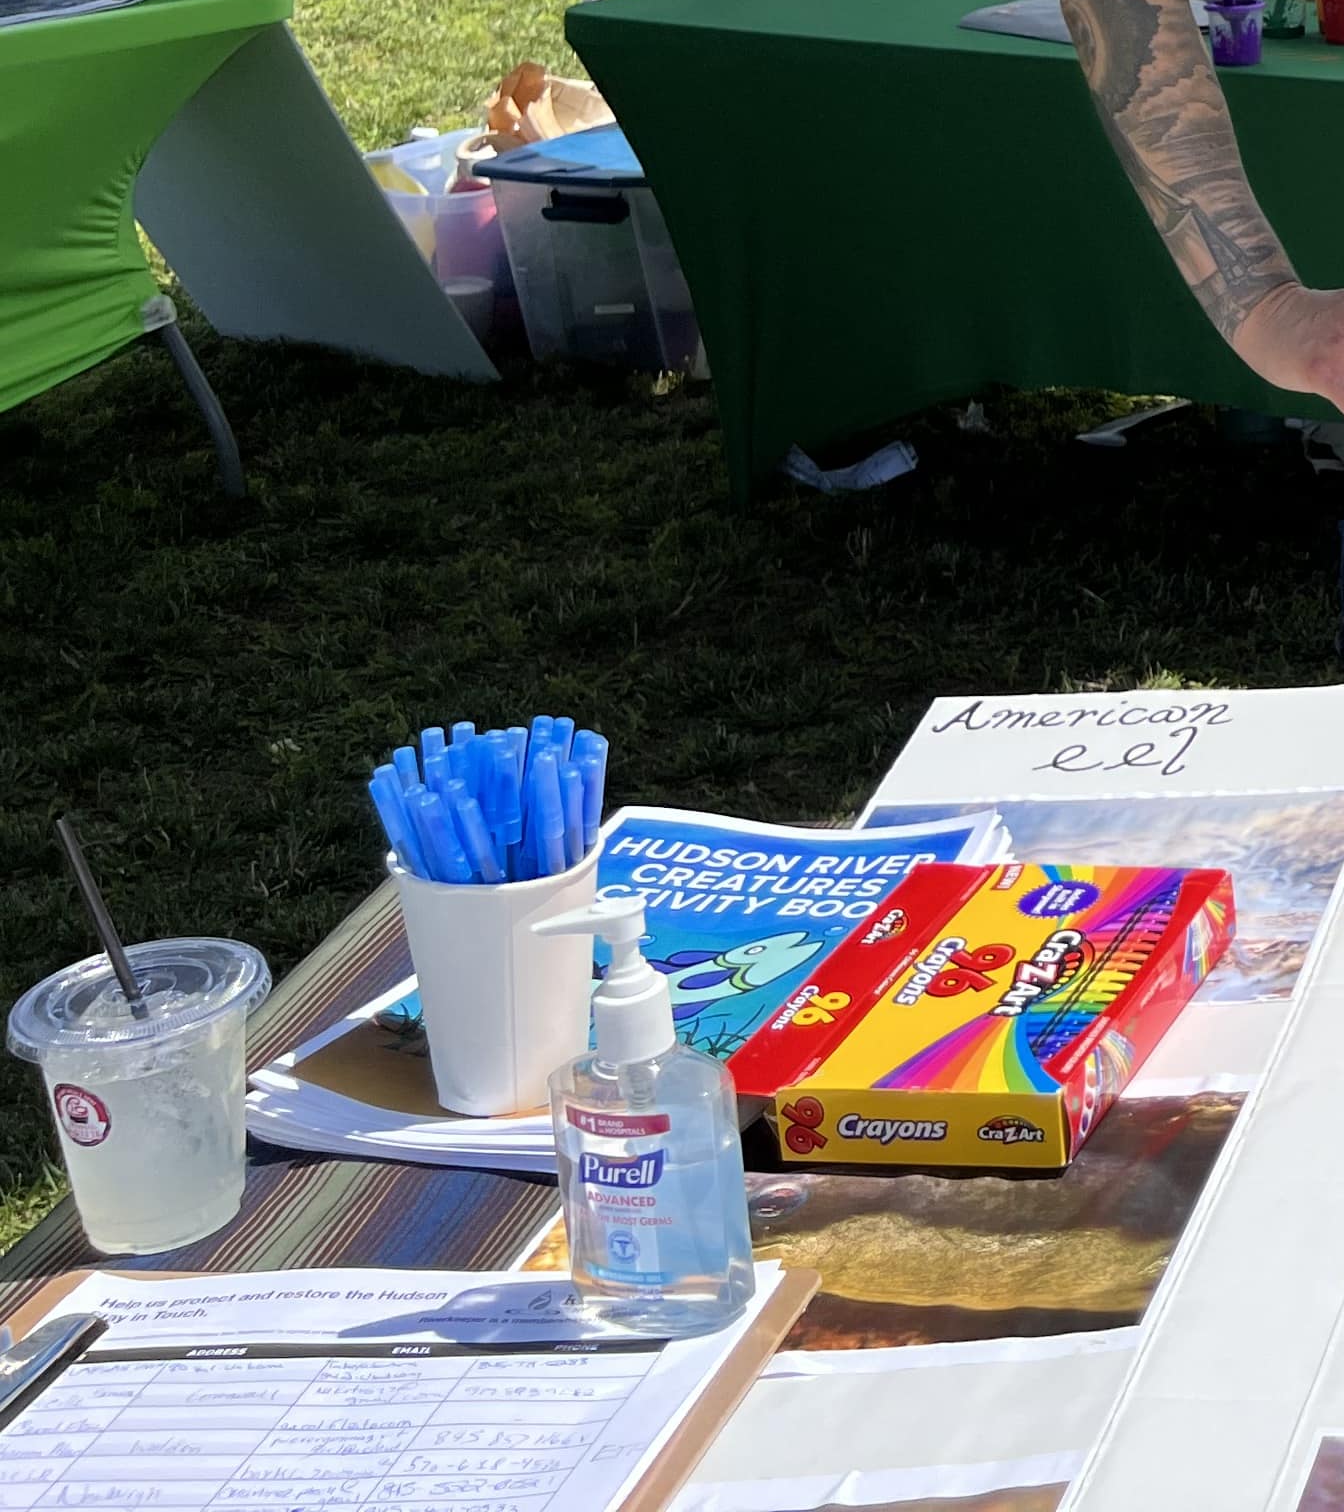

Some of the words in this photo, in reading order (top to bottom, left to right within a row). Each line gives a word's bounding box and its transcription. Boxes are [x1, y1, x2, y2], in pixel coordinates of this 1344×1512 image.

[933, 701, 1233, 732] American
[1032, 727, 1198, 775] eel
[609, 836, 800, 873] HUDSON
[631, 863, 890, 898] CREATURES
[600, 884, 777, 915] CTIVITY
[775, 898, 879, 919] BOO
[895, 937, 967, 1004] Crayons
[925, 944, 1016, 997] 96
[770, 985, 820, 1030] Crayons
[792, 991, 851, 1026] 96
[781, 1096, 829, 1155] 96
[836, 1114, 947, 1145] Crayons
[587, 1191, 657, 1208] ADVANCED
[100, 1298, 141, 1310] Help
[145, 1299, 168, 1308] us
[168, 1294, 237, 1308] protect
[238, 1291, 275, 1301] and
[276, 1290, 339, 1300] restore
[341, 1290, 376, 1300] the
[377, 1290, 449, 1300] Hudson
[130, 1312, 149, 1322] in
[186, 1346, 248, 1357] ADDRESS
[391, 1345, 431, 1355] EMAIL
[554, 1342, 599, 1352] PHONE
